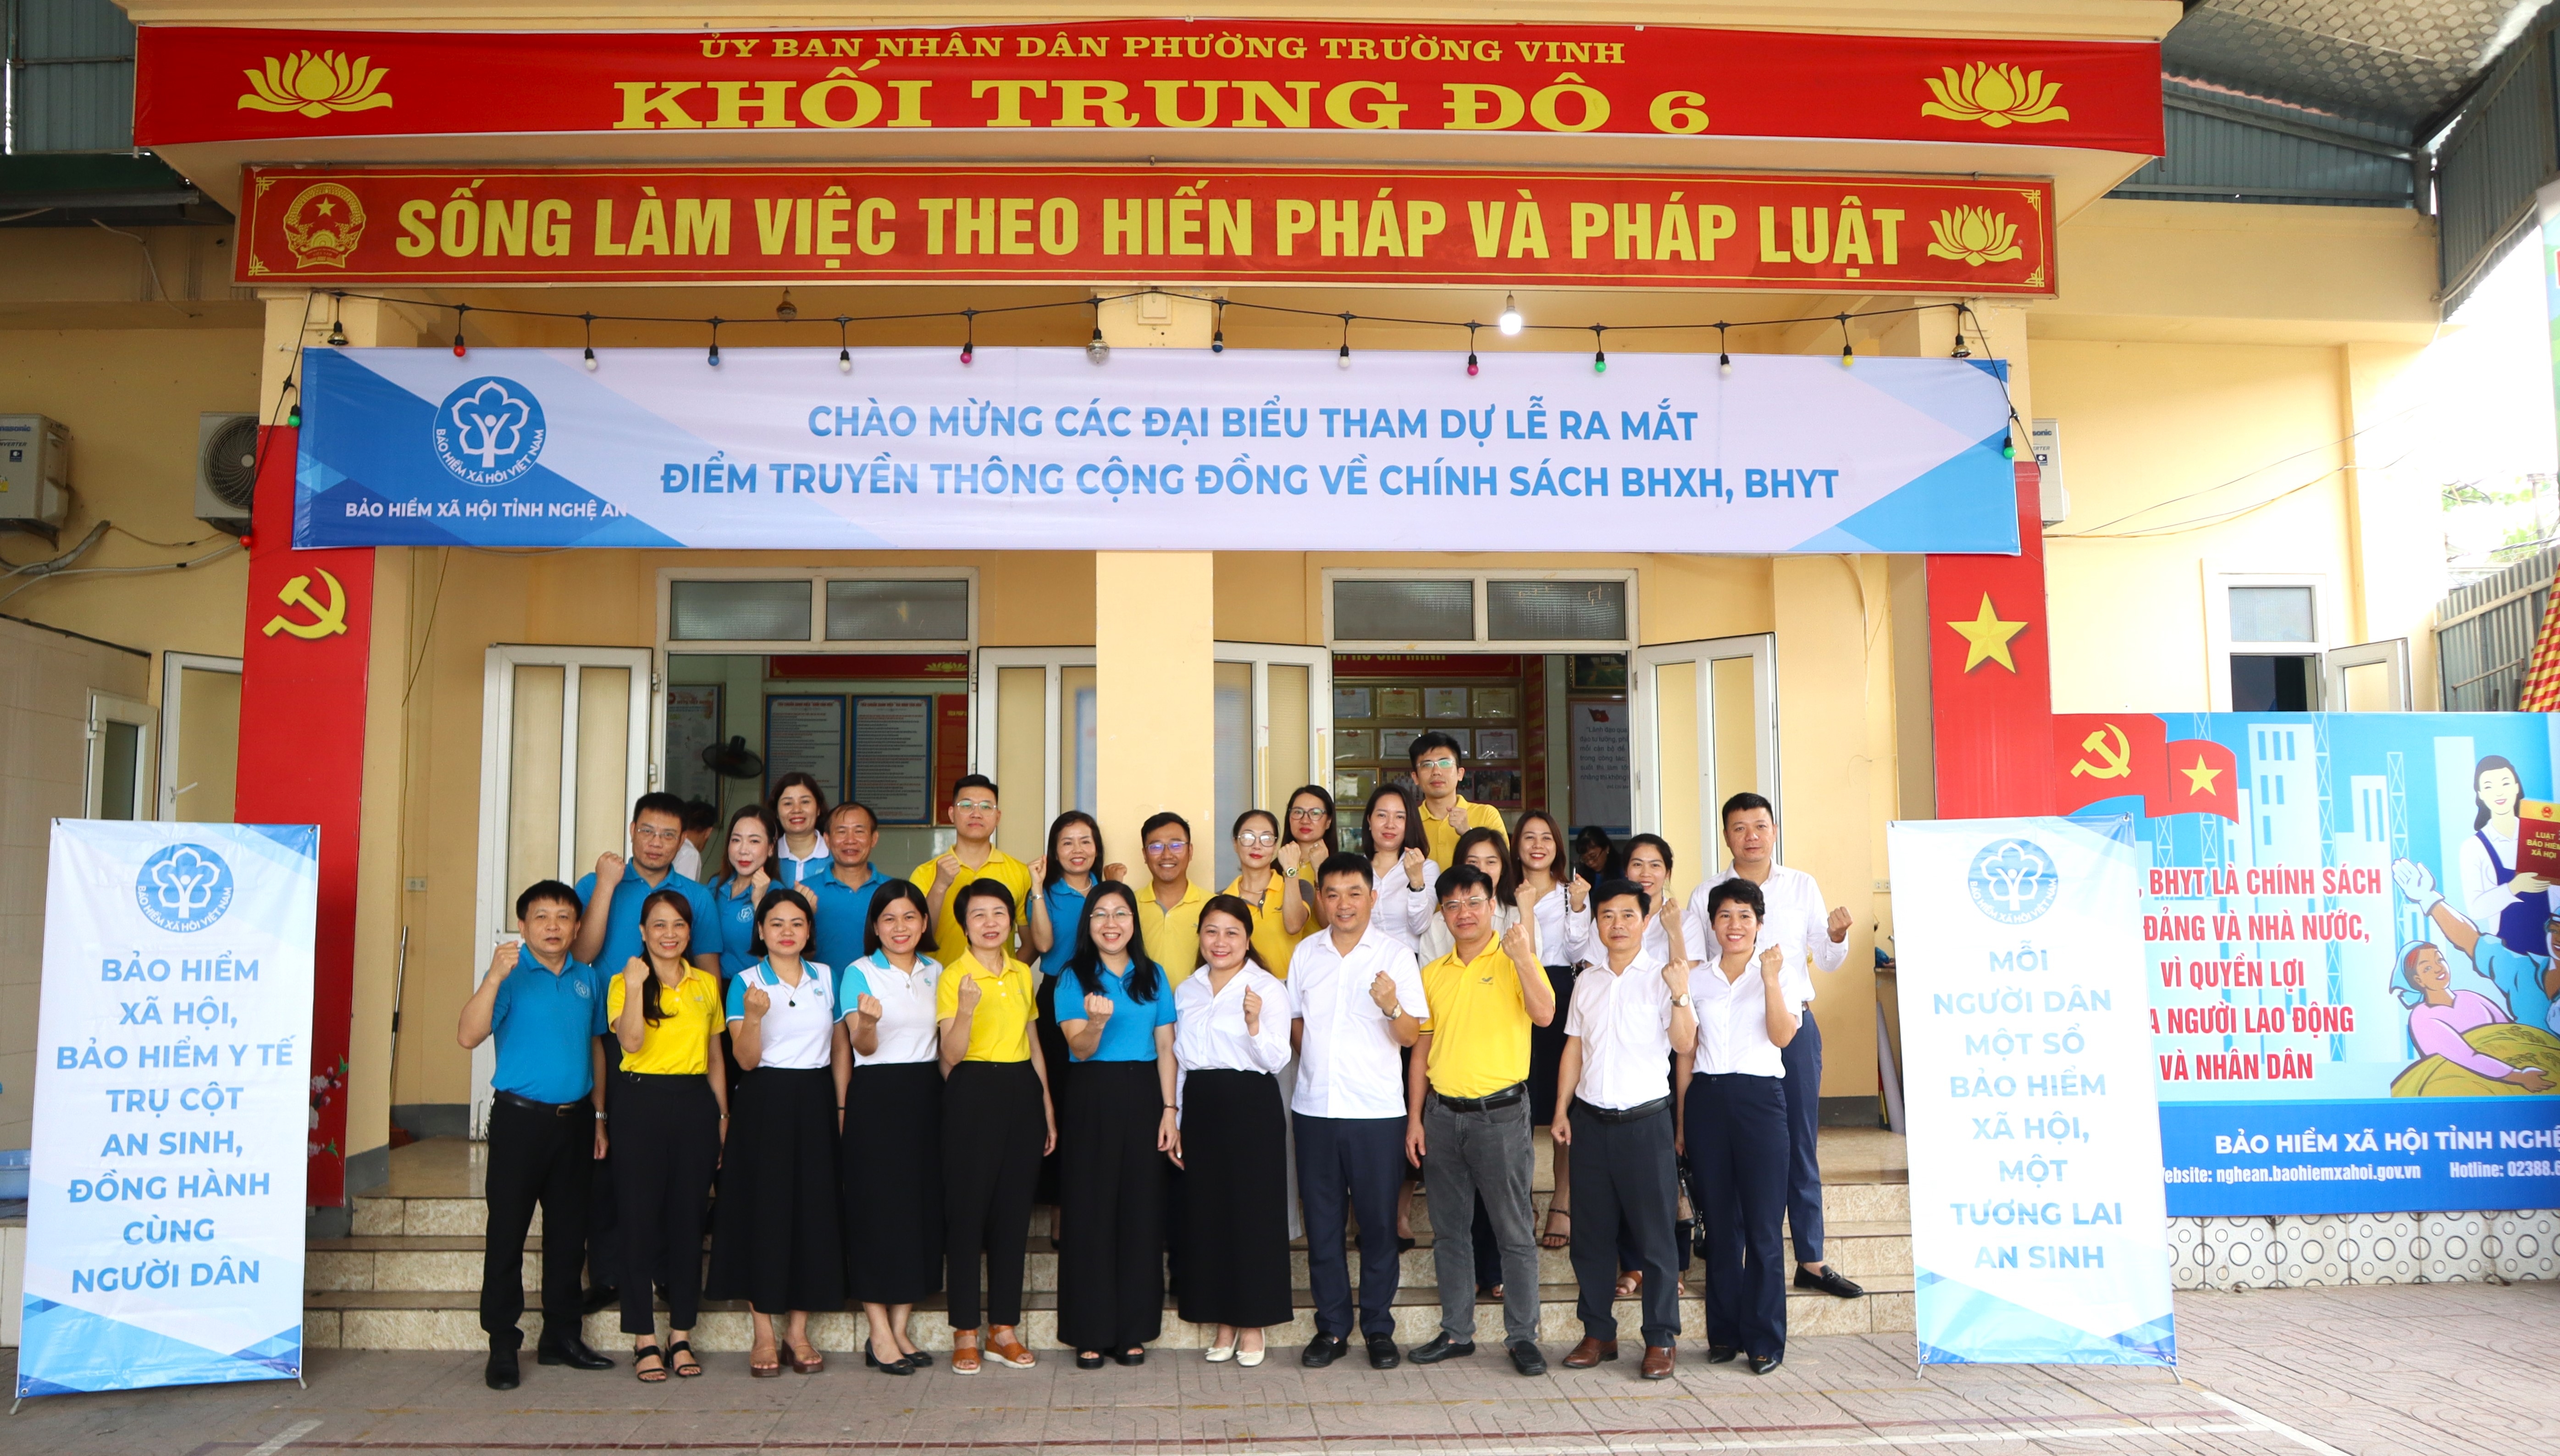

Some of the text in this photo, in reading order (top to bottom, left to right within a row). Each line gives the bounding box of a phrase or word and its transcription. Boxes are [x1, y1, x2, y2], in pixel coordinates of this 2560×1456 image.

[700, 32, 1625, 63] ỦY BAN NHÂN DÂN PHƯỜNG TRƯỜNG VINH
[613, 60, 1709, 134] KHỐI TRUNG ĐÔ 6
[397, 180, 1905, 277] SỐNG LÀM VIỆC THEO HIẾN PHÁP VÀ PHÁP LUẬT
[810, 396, 1697, 447] CHÀO MỪNG CÁC ĐẠI BIỂU THAM DỰ LỄ RA MẮT
[437, 429, 448, 452] BẢO
[528, 429, 544, 456] NAM
[661, 451, 1838, 503] ĐIỂM TRUYỀN THÔNG CỘNG ĐỒNG VỀ CHÍNH SÁCH BHXH, BHYT
[346, 498, 628, 520] BẢO HIỂM XÃ HỘI TỈNH NGHỆ AN
[1970, 881, 1981, 900] BẢO
[2045, 878, 2057, 900] NAM
[2150, 864, 2381, 894] BHYT LÀ CHÍNH SÁCH
[138, 886, 149, 905] BẢO
[218, 887, 232, 910] NAM
[2144, 907, 2369, 942] ĐẢNG VÀ NHÀ NƯỚC,
[102, 950, 258, 982] BẢO HIỂM
[1990, 940, 2047, 971] MỖI
[2161, 953, 2304, 993] VÌ QUYỀN LỢI
[120, 996, 237, 1030] XÃ HỘI,
[1934, 984, 2111, 1015] NGƯỜI DÂN
[2168, 1002, 2236, 1034] NGƯỜI
[2245, 1007, 2284, 1033] LAO
[2293, 1002, 2353, 1038] ĐỘNG
[57, 1035, 296, 1069] BẢO HIỂM Y TẾ
[1966, 1023, 2084, 1061] MỘT SỔ
[2160, 1048, 2312, 1080] VÀ NHÂN DÂN
[1951, 1065, 2106, 1097] BẢO HIỂM
[106, 1081, 243, 1118] TRỤ CỘT
[1973, 1111, 2089, 1144] XÃ HỘI,
[2216, 1128, 2269, 1154] BẢO
[2276, 1127, 2338, 1153] HIỂM
[2344, 1129, 2379, 1152] XÃ
[2385, 1128, 2428, 1155] HỘI
[2434, 1125, 2492, 1149] TỈNH
[102, 1131, 242, 1157] AN SINH,
[68, 1169, 269, 1202] ĐỒNG HÀNH
[1999, 1154, 2068, 1188] MỘT
[2217, 1164, 2421, 1184] nghean.baohiemxahoi.gov.vn
[2450, 1162, 2504, 1177] Hotline:
[1951, 1199, 2122, 1225] TƯƠNG LAI
[123, 1214, 214, 1245] CÙNG
[1974, 1246, 2104, 1268] AN SINH
[73, 1256, 259, 1293] NGƯỜI DÂN
